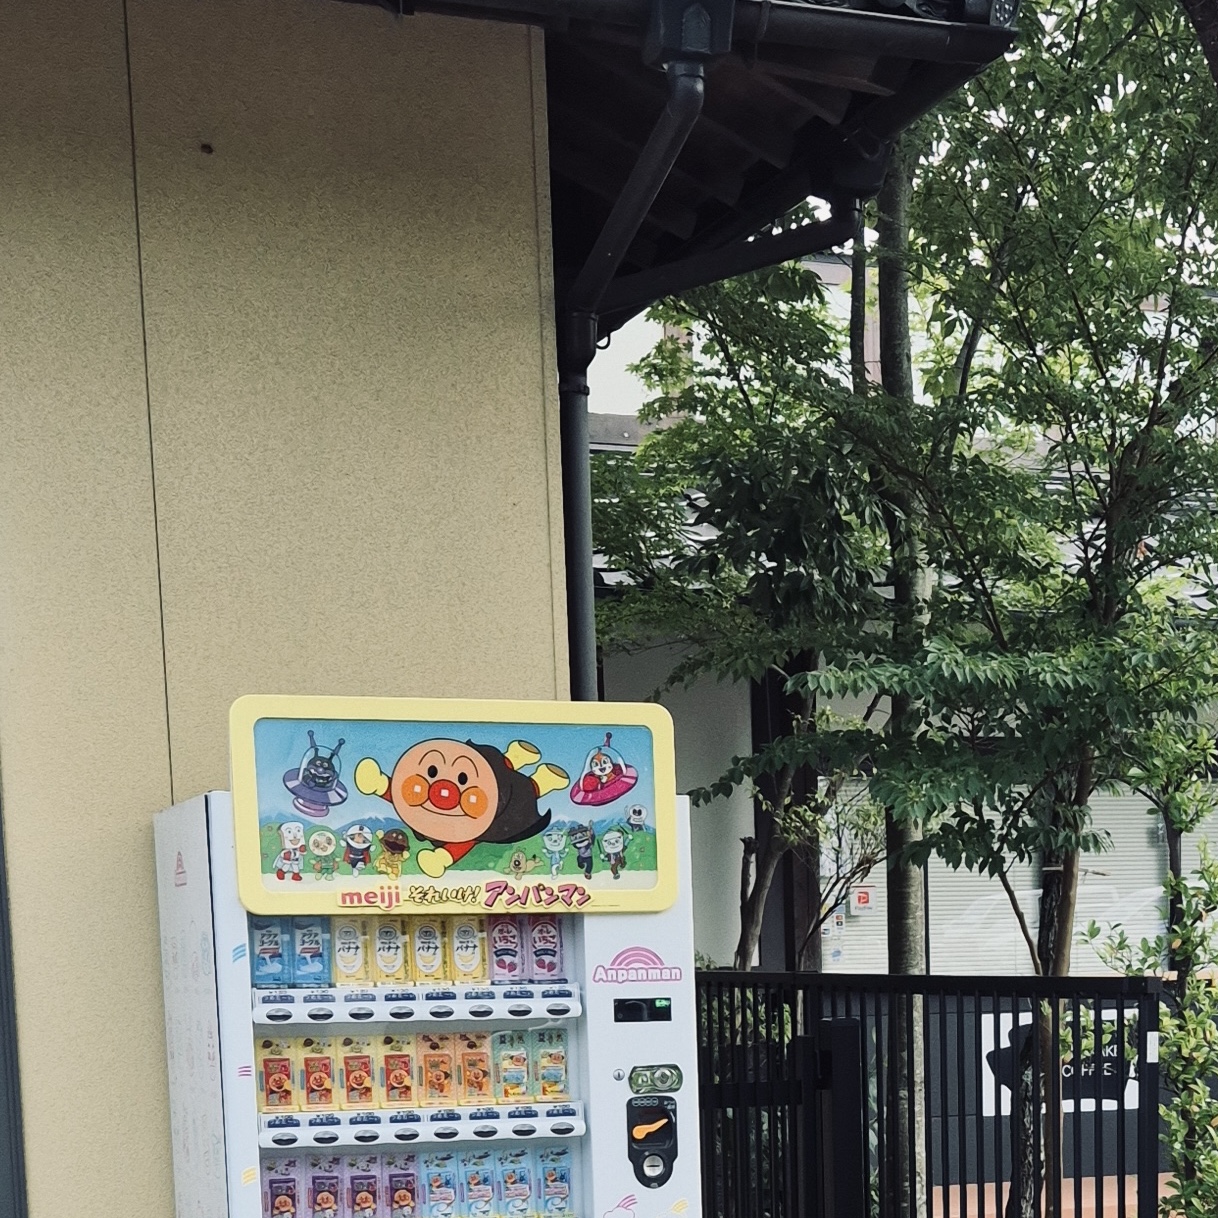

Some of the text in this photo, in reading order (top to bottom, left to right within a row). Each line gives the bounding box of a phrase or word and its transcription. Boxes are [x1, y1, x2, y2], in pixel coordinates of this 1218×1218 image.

[341, 885, 401, 908] meiji
[484, 881, 591, 908] アンパンマン
[592, 965, 682, 984] Anpanman
[1062, 1062, 1113, 1078] CFFE
